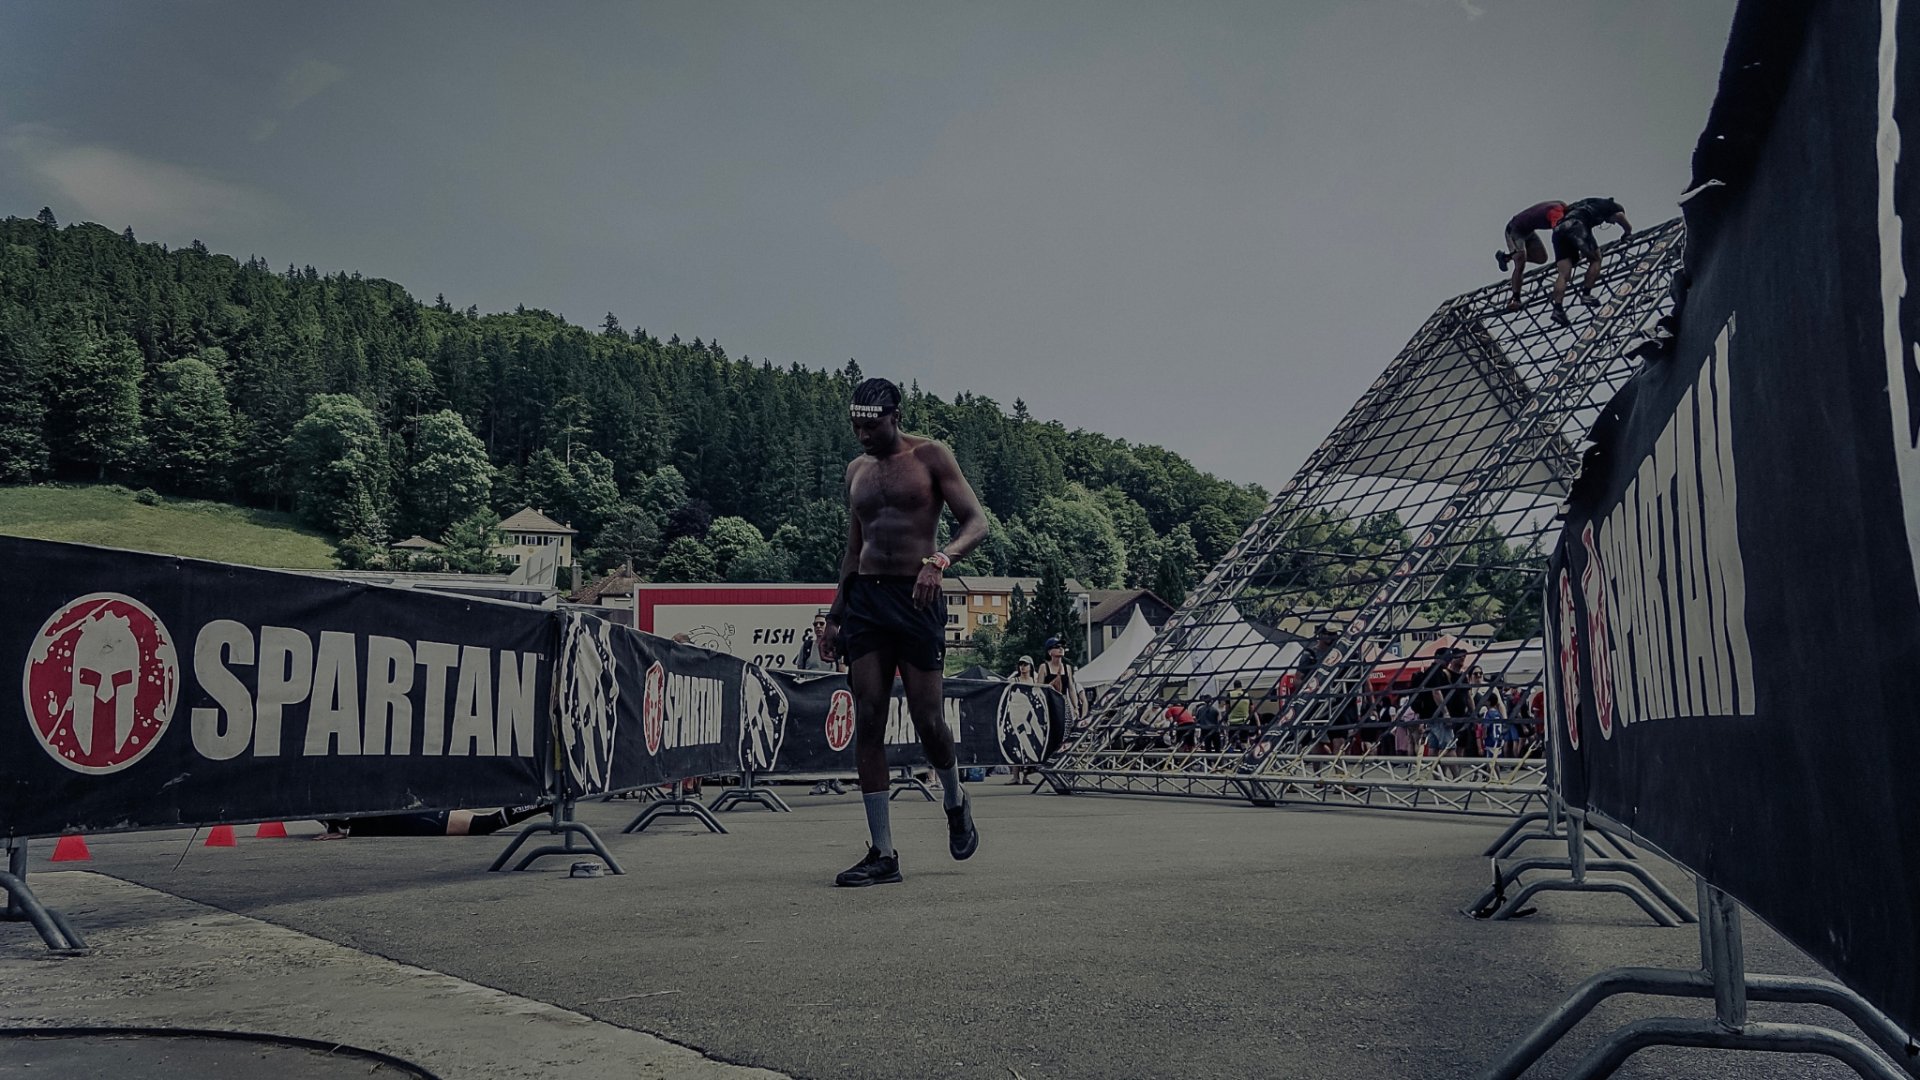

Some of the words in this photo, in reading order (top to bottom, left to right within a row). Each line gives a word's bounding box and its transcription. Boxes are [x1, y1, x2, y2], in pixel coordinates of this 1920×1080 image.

[1598, 323, 1756, 729] SPARTAN
[753, 628, 795, 644] FISH
[753, 654, 786, 668] 079
[190, 619, 536, 760] SPARTAN
[664, 671, 723, 750] SPARTAN
